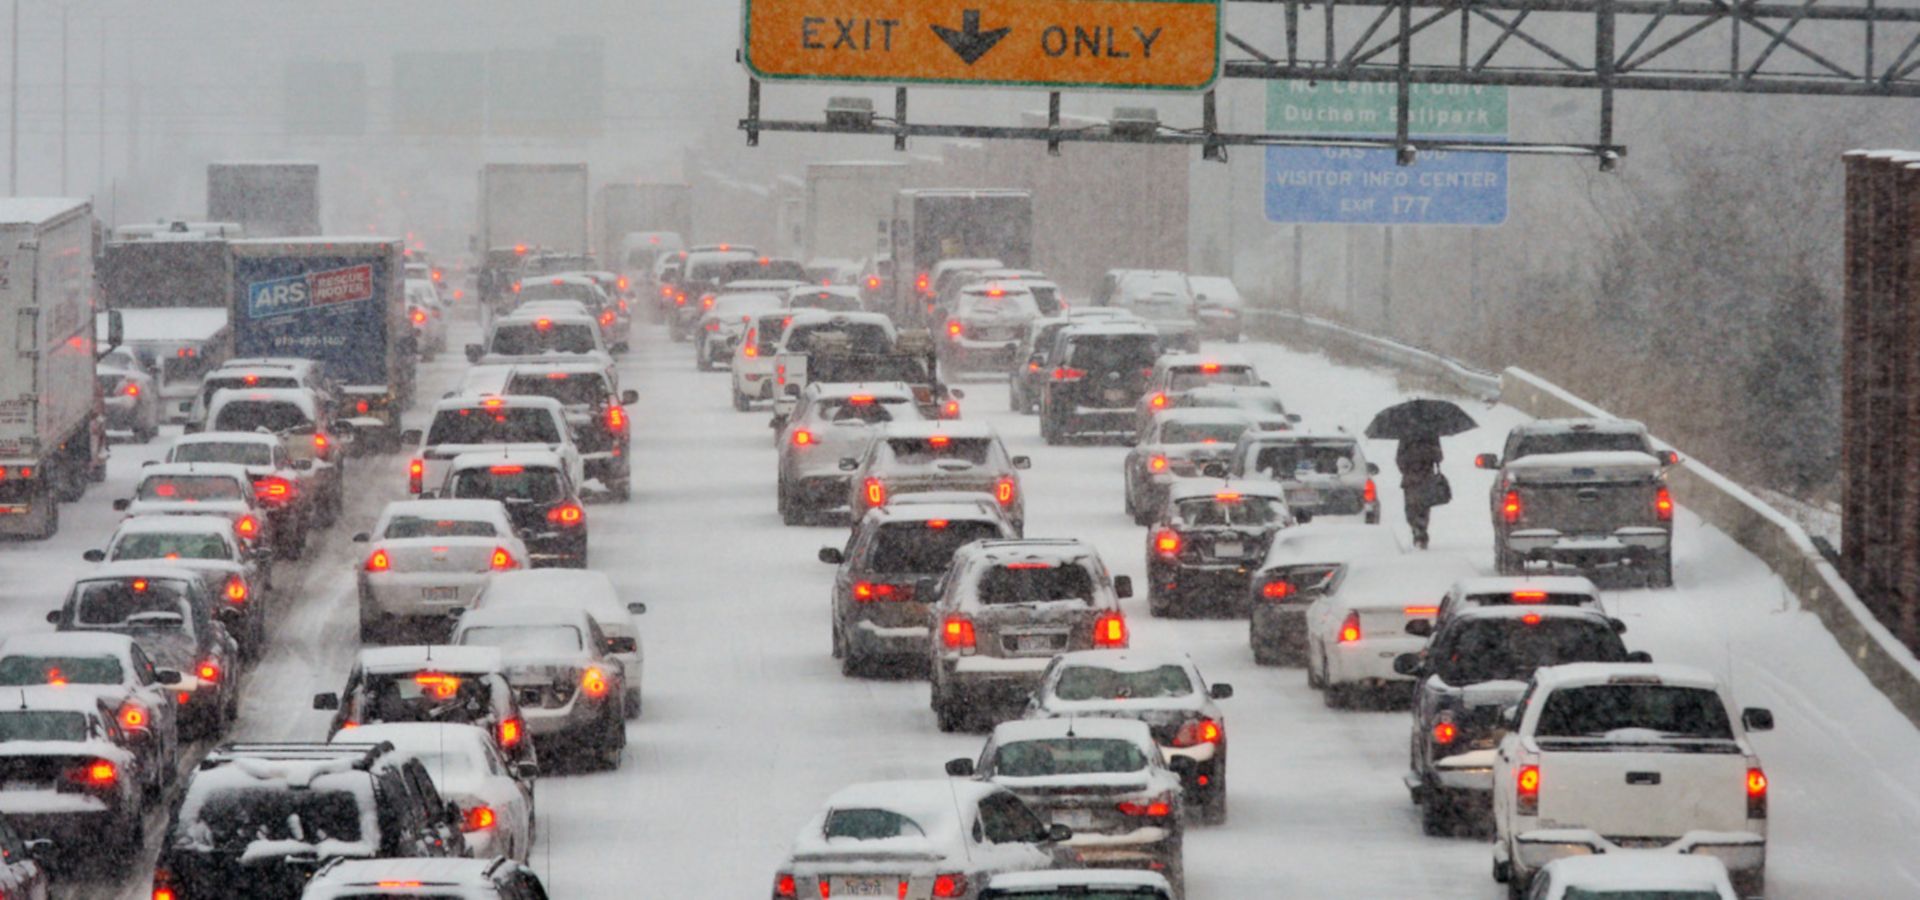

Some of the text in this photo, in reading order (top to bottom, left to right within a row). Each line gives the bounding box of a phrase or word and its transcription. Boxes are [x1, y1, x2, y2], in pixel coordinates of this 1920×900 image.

[801, 17, 1163, 59] EXIT ONLY
[1323, 147, 1366, 160] GAS
[1276, 170, 1498, 187] VISITOR INFO CENTER
[1340, 196, 1433, 215] EXIT 177
[317, 272, 365, 288] RESCUE
[254, 281, 305, 309] ARS
